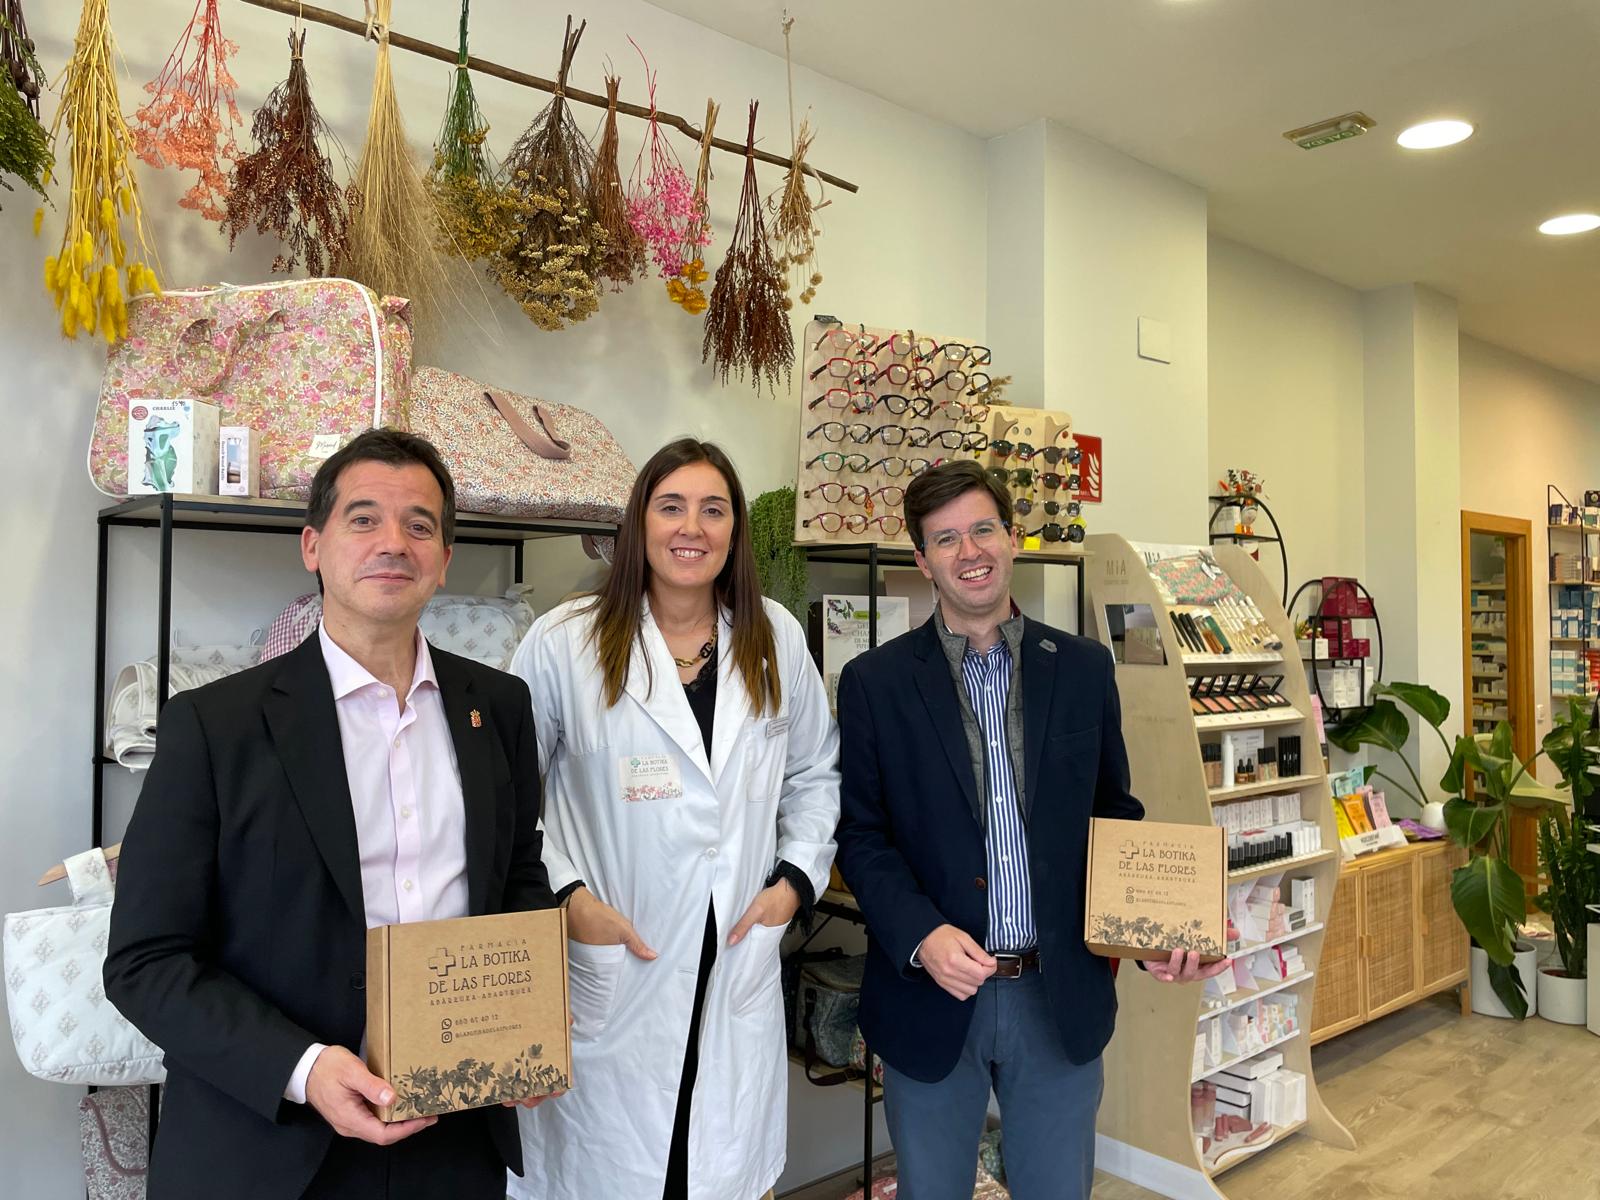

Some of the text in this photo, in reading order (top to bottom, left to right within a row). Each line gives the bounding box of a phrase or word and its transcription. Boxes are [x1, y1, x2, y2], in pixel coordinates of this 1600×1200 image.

[1142, 848, 1196, 861] LA BOTIKA
[1119, 861, 1197, 875] DE LAS FLORES
[460, 939, 527, 952] FARMACIA
[461, 949, 531, 969] LA BOTIKA
[428, 970, 532, 995] DE LAS FLORES
